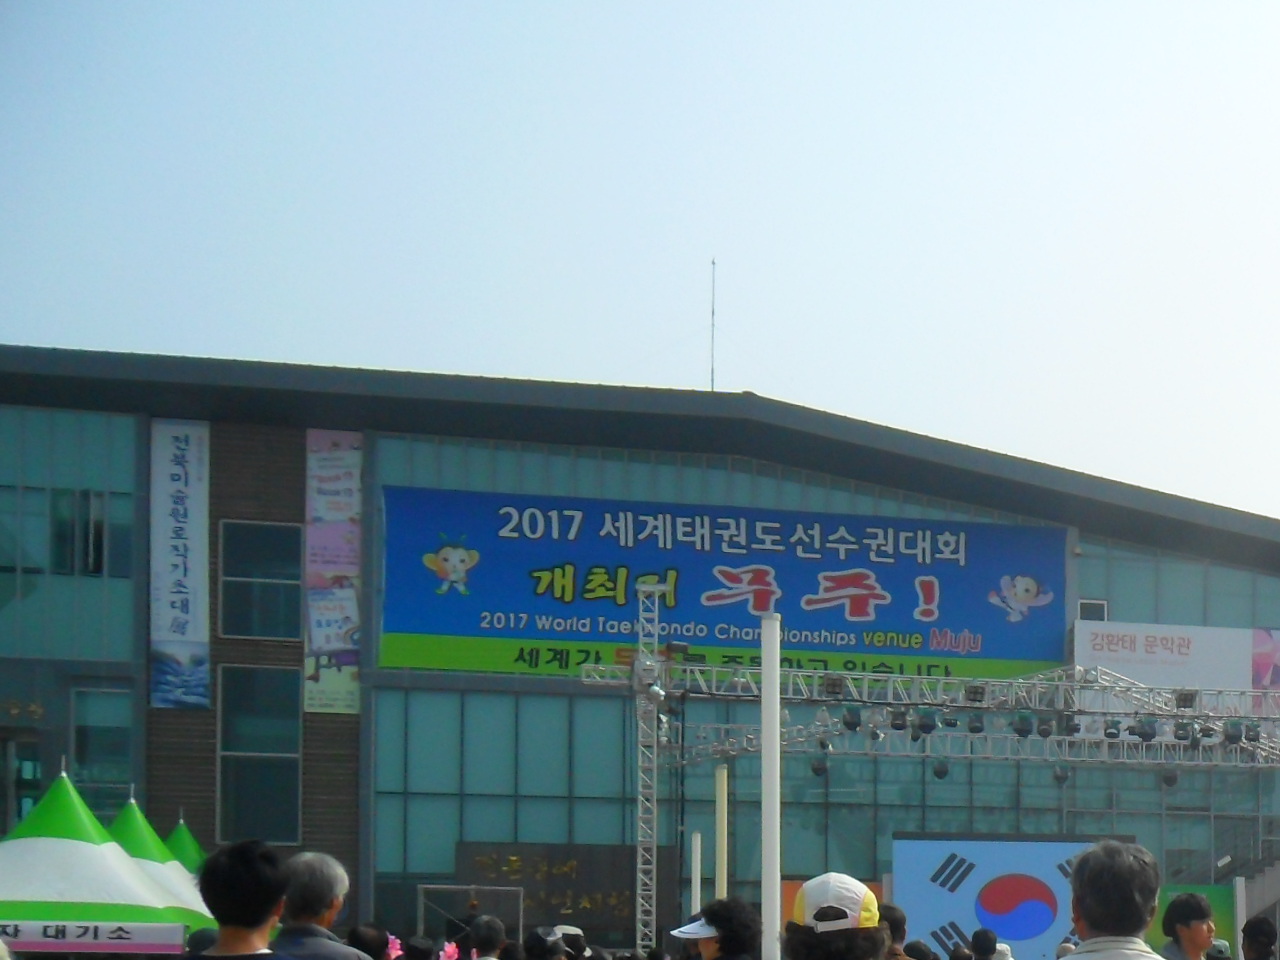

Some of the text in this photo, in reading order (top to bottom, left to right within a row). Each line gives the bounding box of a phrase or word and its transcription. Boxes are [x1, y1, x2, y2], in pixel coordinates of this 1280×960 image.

[498, 506, 966, 566] 2017 세계태권도선수권대회
[480, 611, 528, 629] 2017
[535, 615, 591, 633] World
[714, 623, 857, 646] Chaionships
[863, 631, 923, 649] venue
[929, 627, 982, 655] Muju
[1090, 632, 1192, 656] 김환태 문학관
[42, 924, 132, 941] 대기소
